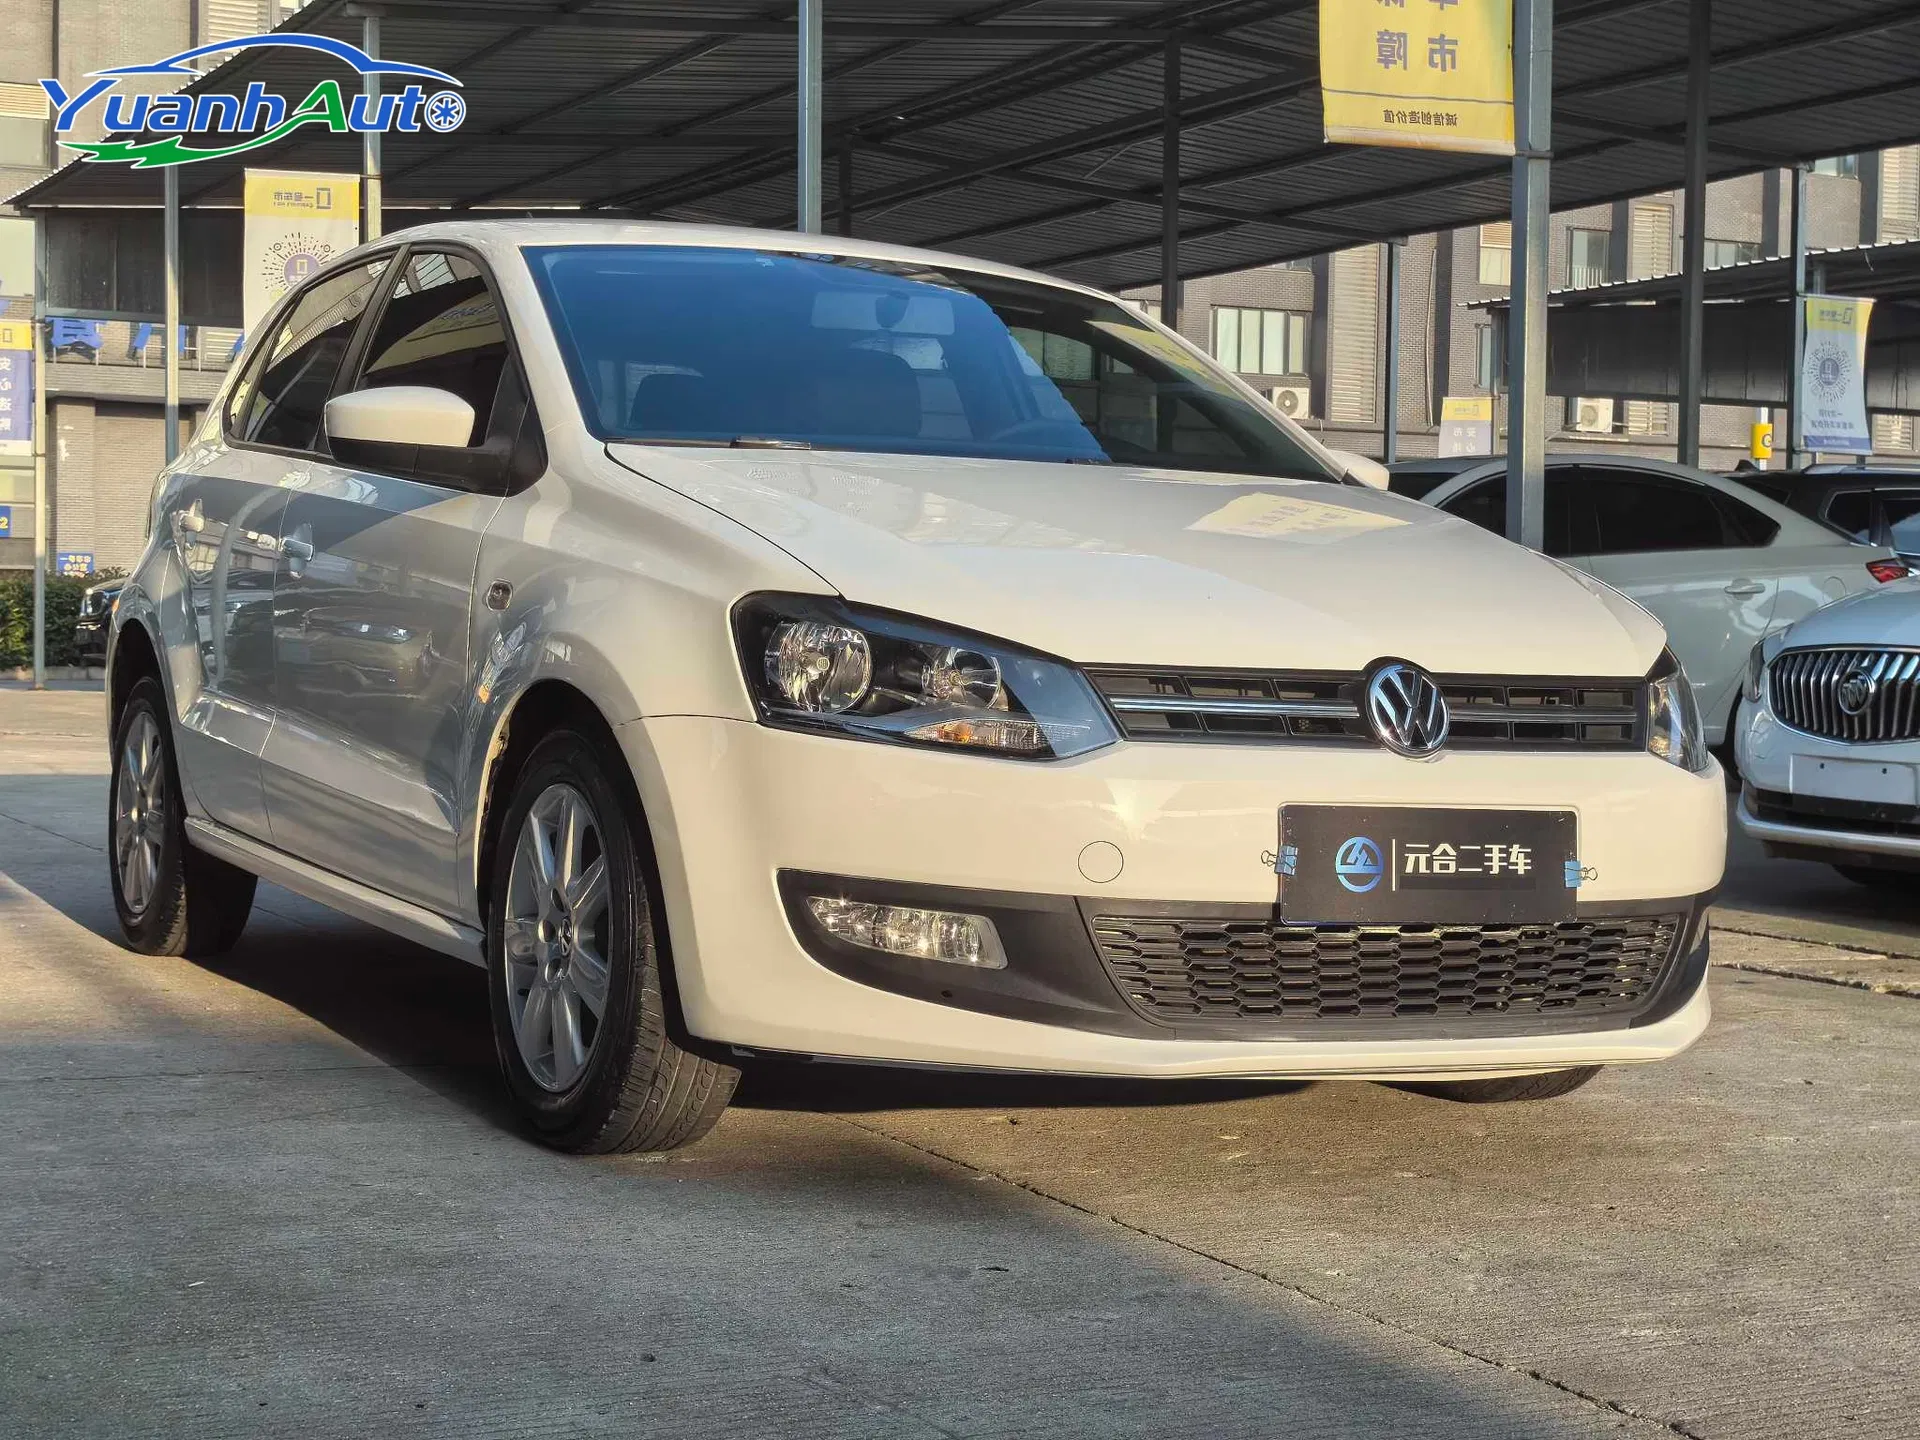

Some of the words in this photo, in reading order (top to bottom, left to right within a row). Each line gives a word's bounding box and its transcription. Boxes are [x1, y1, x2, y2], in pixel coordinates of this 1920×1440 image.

[1404, 843, 1532, 875] 元合二手车
